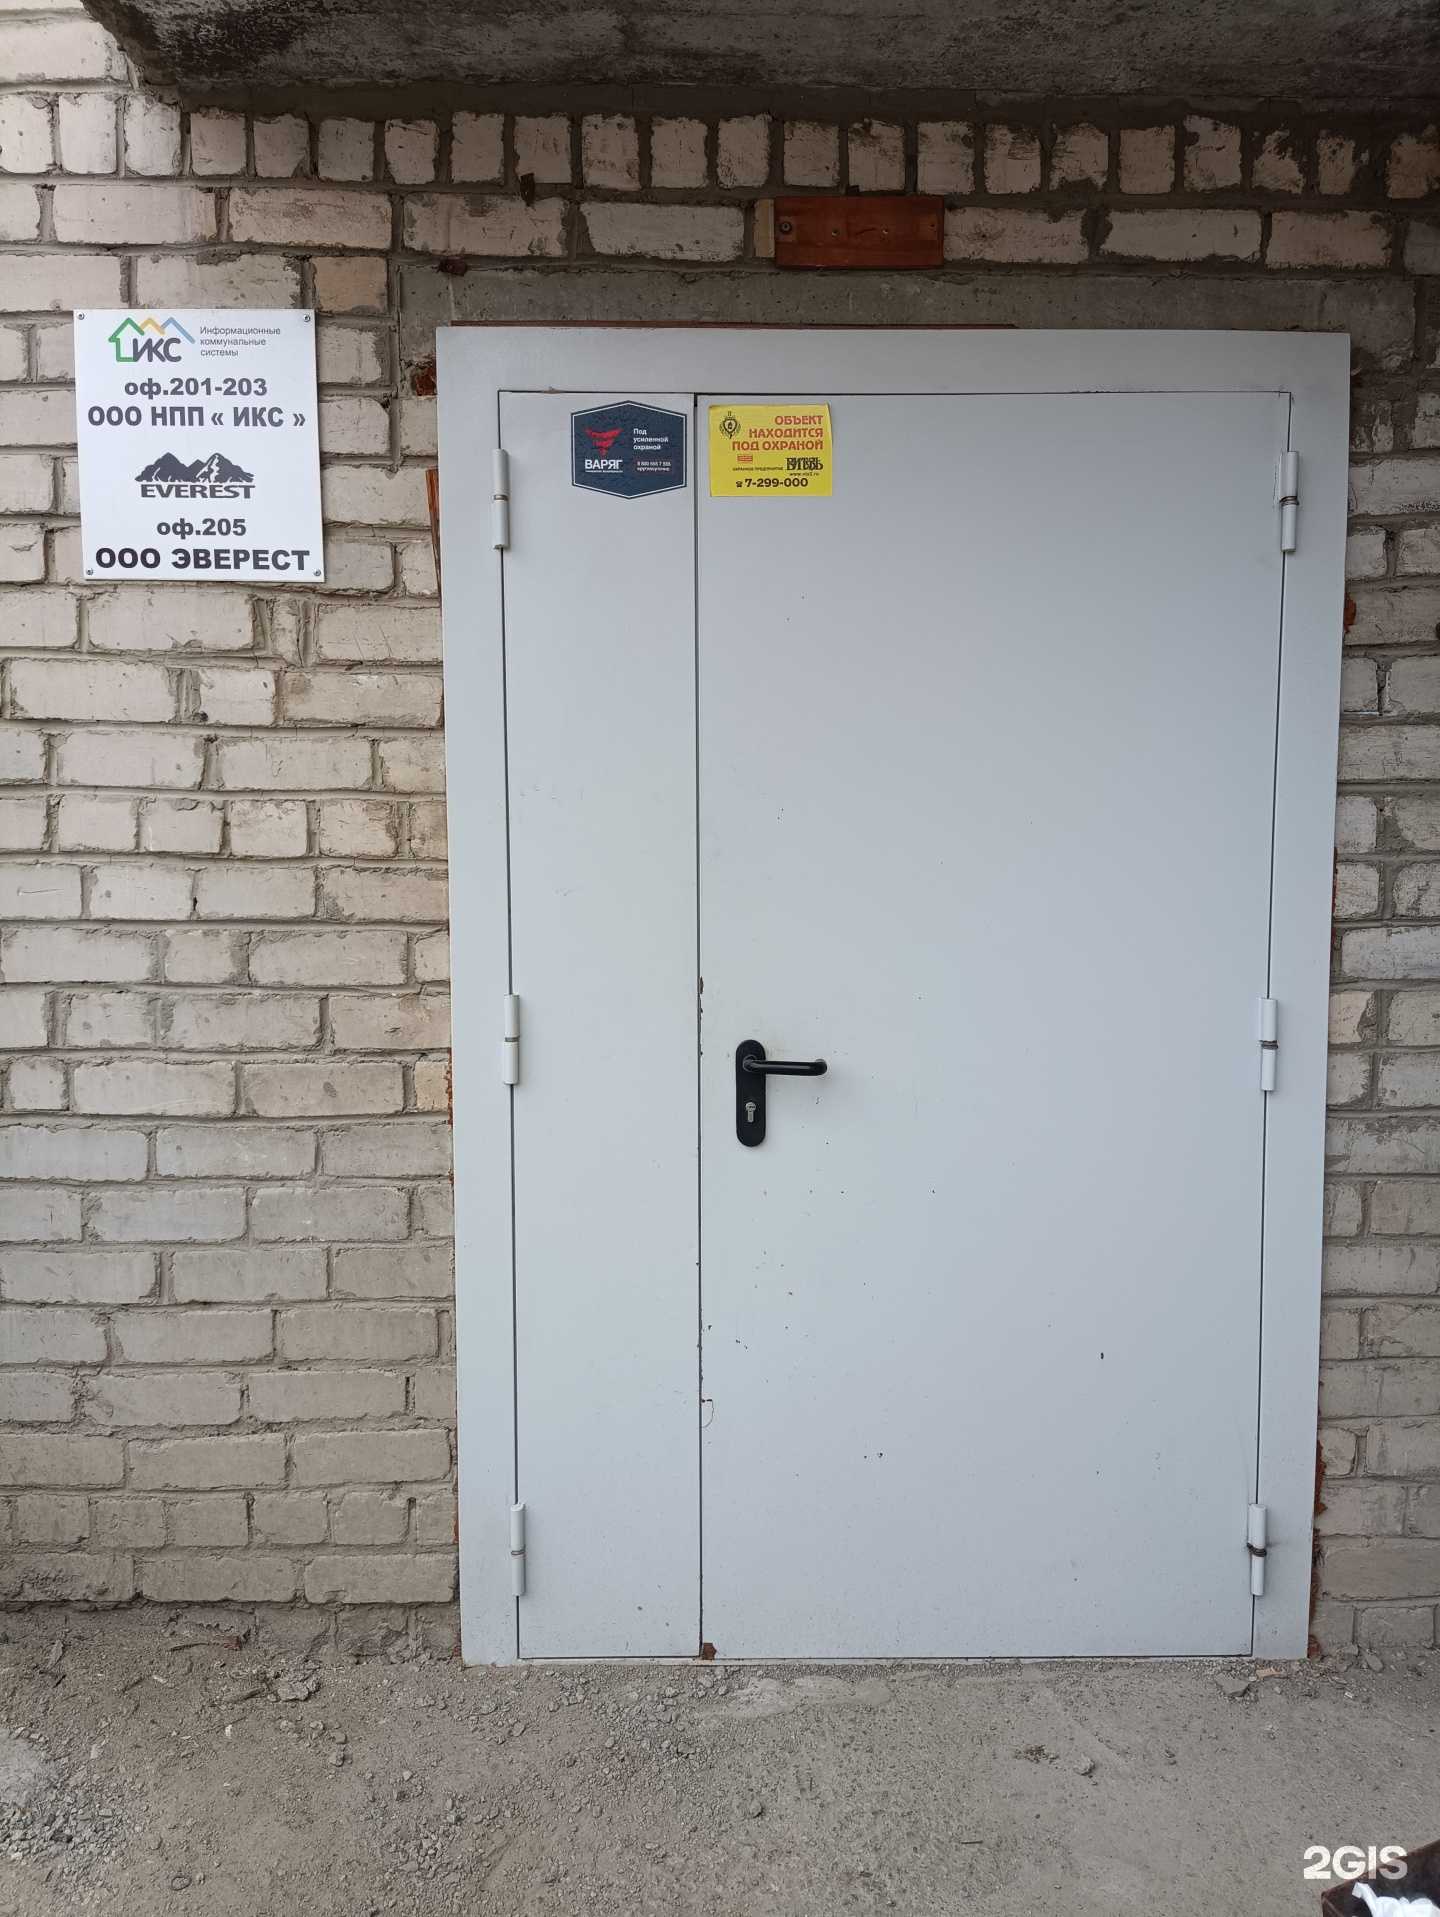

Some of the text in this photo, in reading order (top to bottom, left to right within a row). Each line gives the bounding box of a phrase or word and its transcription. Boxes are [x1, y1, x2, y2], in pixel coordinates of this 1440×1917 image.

[199, 326, 281, 336] Информационные
[199, 338, 267, 347] коммунальные
[133, 337, 182, 362] ИКС
[200, 349, 239, 357] системы
[124, 377, 268, 400] оф.201-203
[87, 406, 142, 427] ООО
[151, 406, 204, 427] НПП
[774, 415, 823, 425] ОБЪЕКТ
[633, 428, 648, 436] Под
[749, 428, 823, 438] НАХОДИТСЯ
[633, 436, 669, 444] усиленной
[732, 439, 823, 451] ПОД ОХРАНОЙ
[633, 443, 661, 451] охраной
[585, 459, 623, 470] ВАРЯГ
[745, 478, 808, 488] 7-299-000
[141, 484, 255, 499] EVEREST
[156, 518, 247, 539] оф.205
[95, 548, 310, 571] ООО ЭВЕРЕСТ
